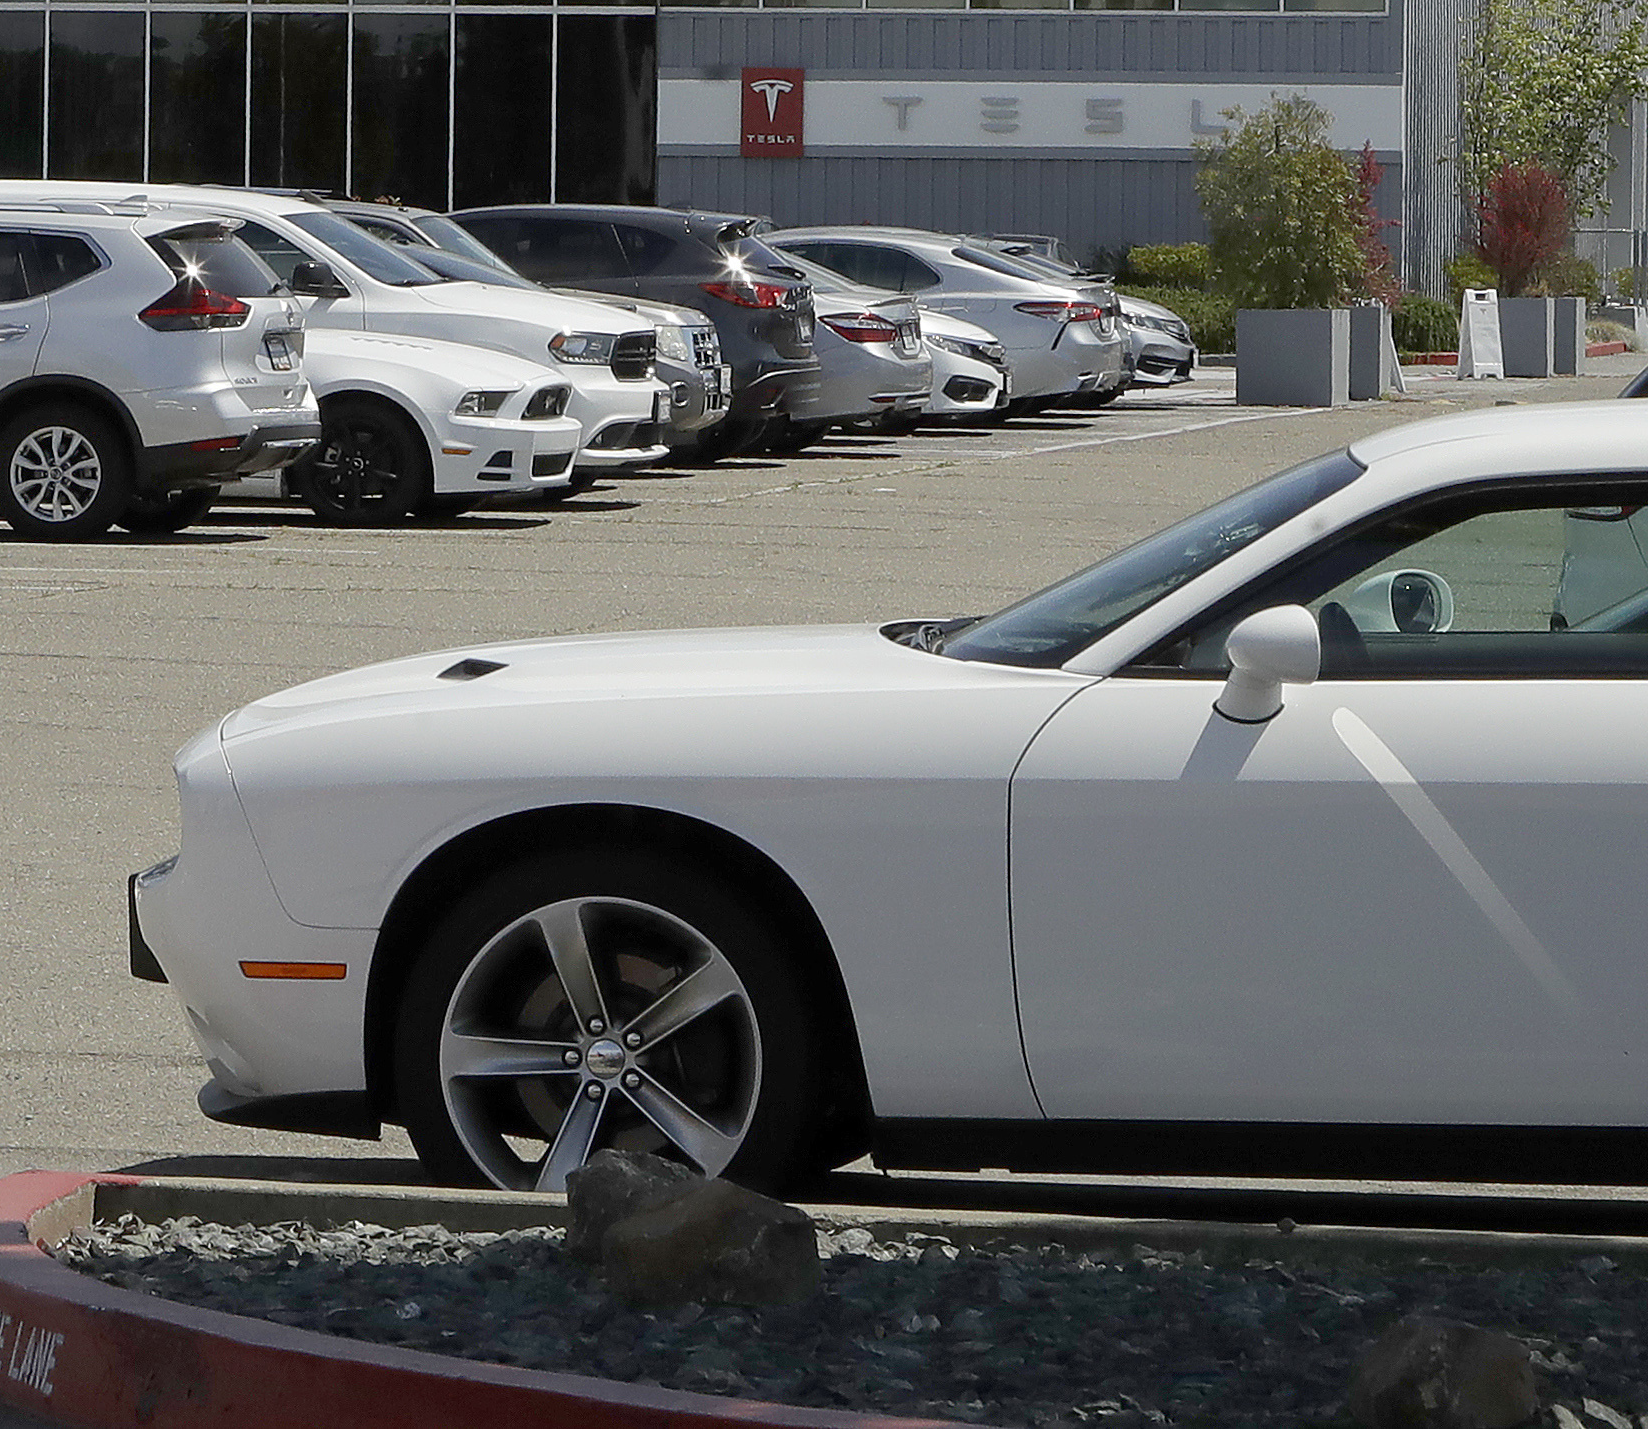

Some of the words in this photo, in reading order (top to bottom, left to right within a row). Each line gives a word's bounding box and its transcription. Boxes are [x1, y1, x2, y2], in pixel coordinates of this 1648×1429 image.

[882, 95, 1228, 136] TESL
[746, 134, 795, 144] TESLA
[8, 1321, 64, 1396] LANE
